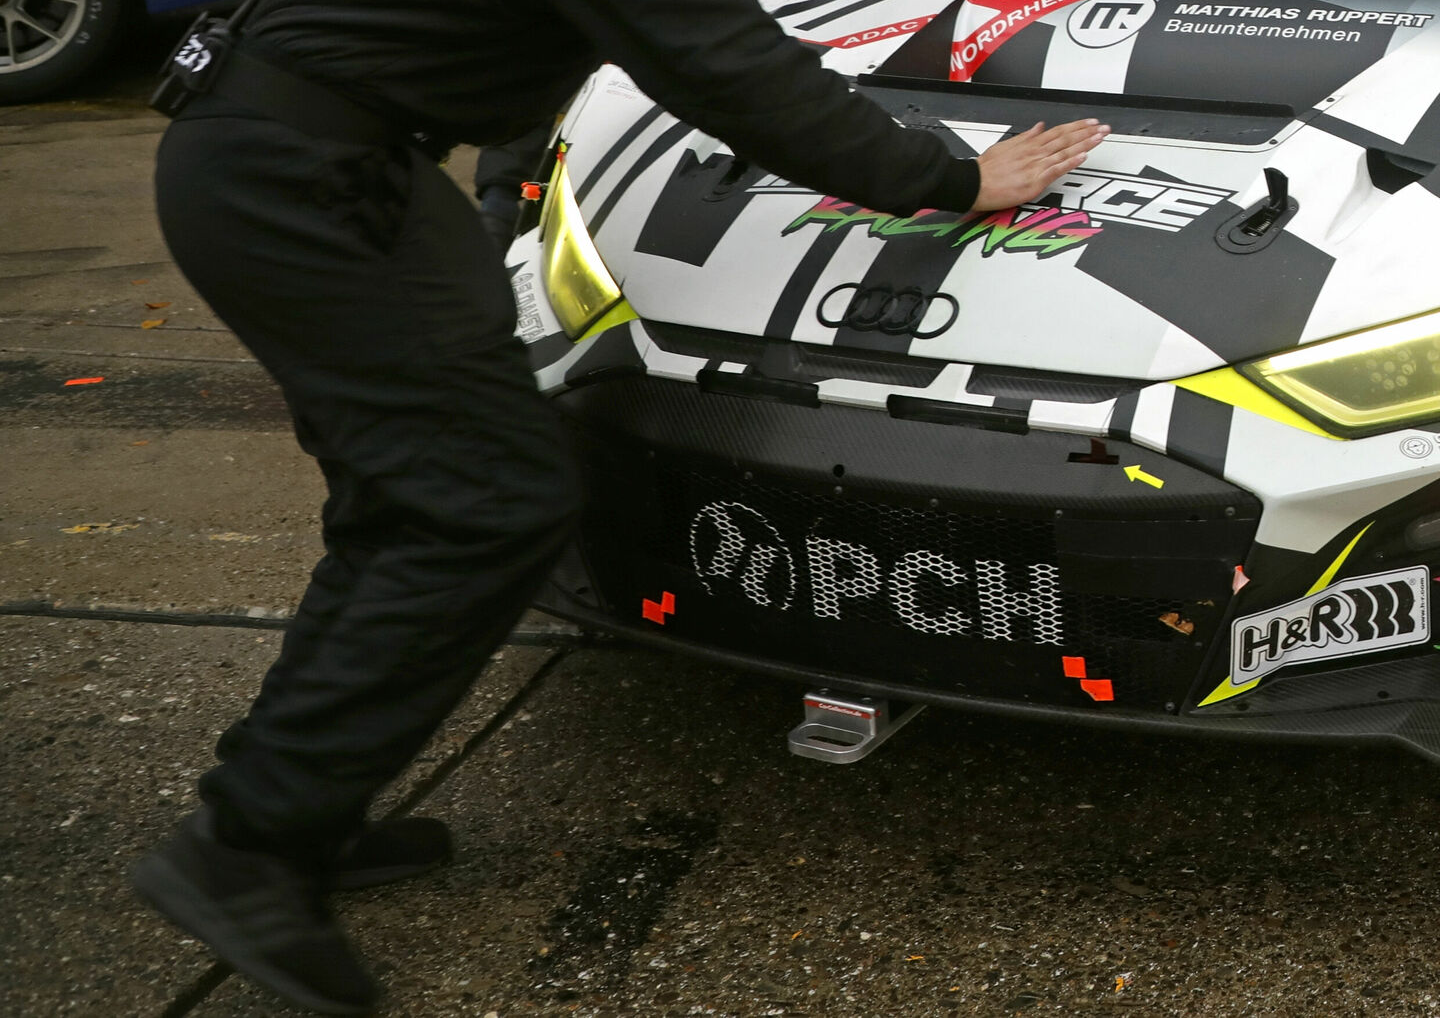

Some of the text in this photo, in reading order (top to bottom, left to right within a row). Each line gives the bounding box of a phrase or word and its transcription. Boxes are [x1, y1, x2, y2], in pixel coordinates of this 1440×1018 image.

[1163, 18, 1362, 43] Bauunternehmen
[1174, 3, 1435, 29] MATTHIAS RUPPERT
[805, 534, 1066, 647] PCH
[1242, 595, 1346, 670] H&R
